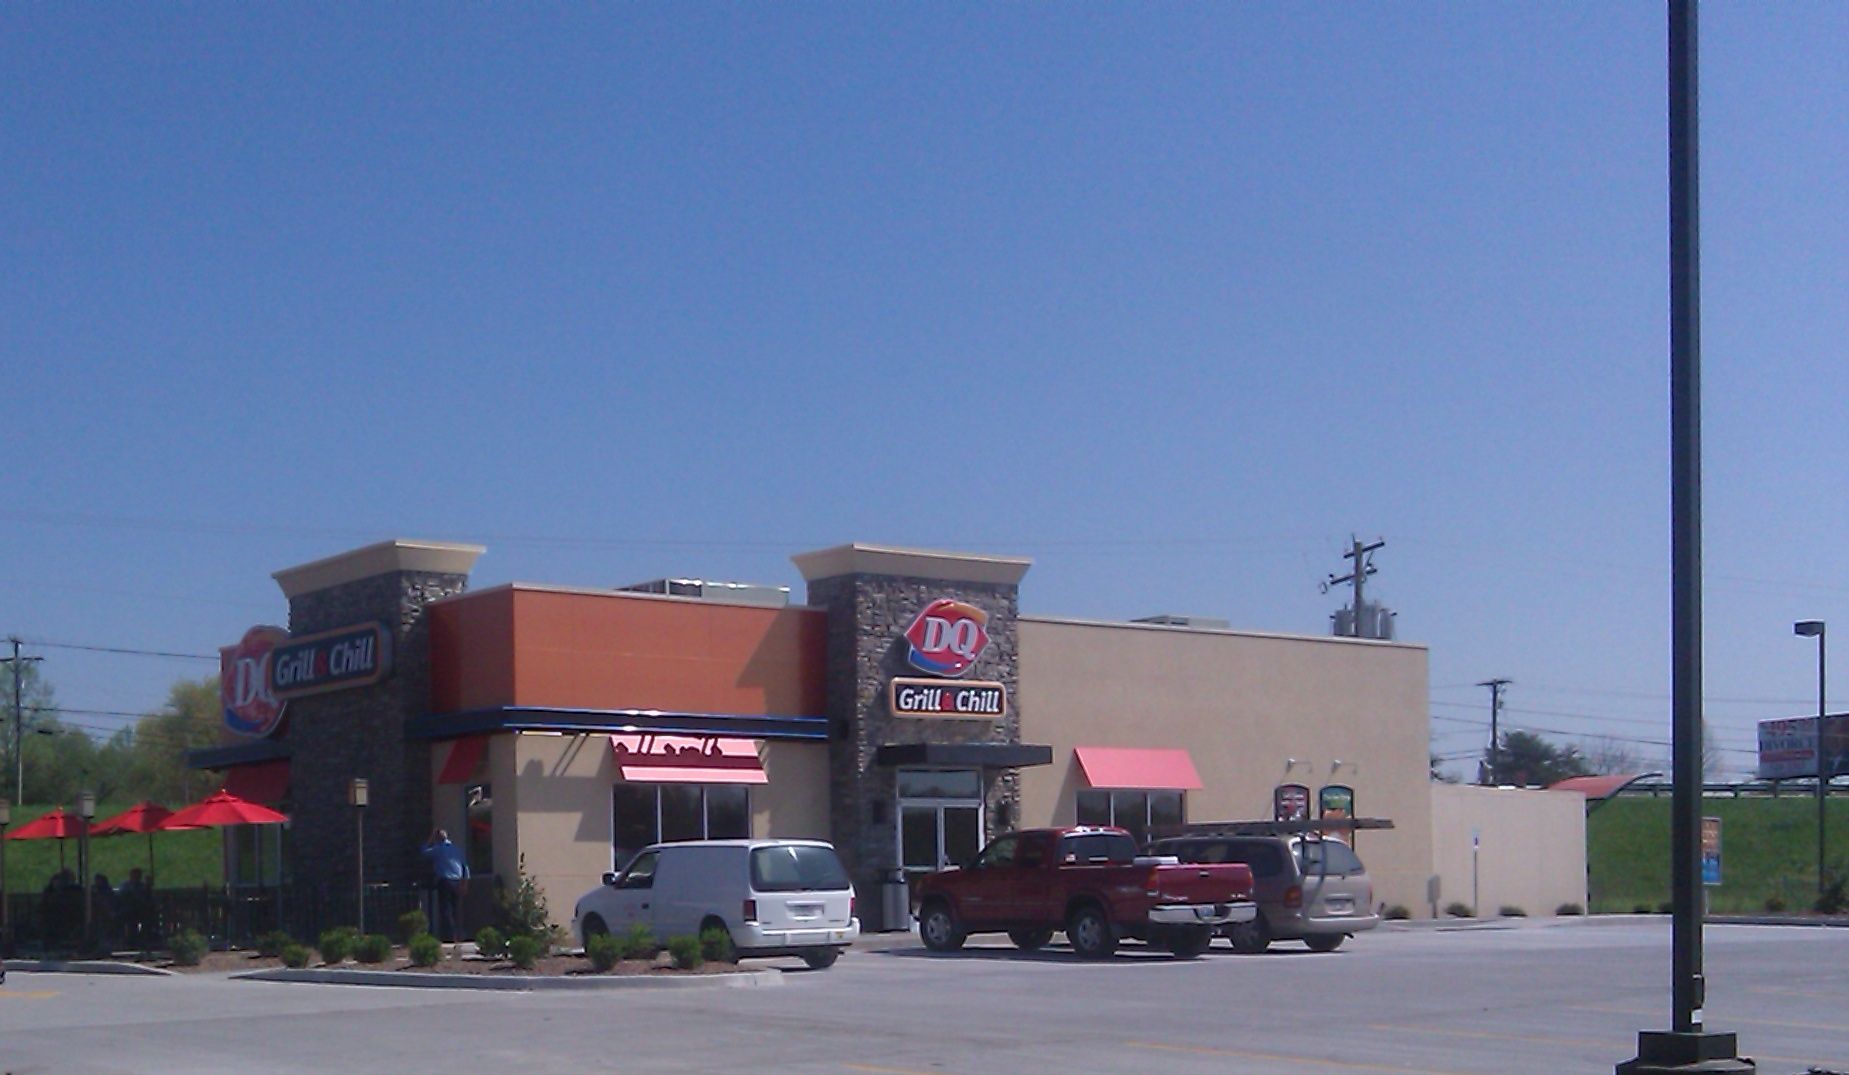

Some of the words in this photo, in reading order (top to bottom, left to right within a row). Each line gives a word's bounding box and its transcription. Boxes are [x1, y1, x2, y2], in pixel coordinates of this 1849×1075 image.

[922, 616, 978, 661] DQ
[277, 650, 315, 686] Grill
[329, 637, 373, 674] Chill
[899, 688, 942, 711] Grill
[956, 690, 1000, 713] Chill
